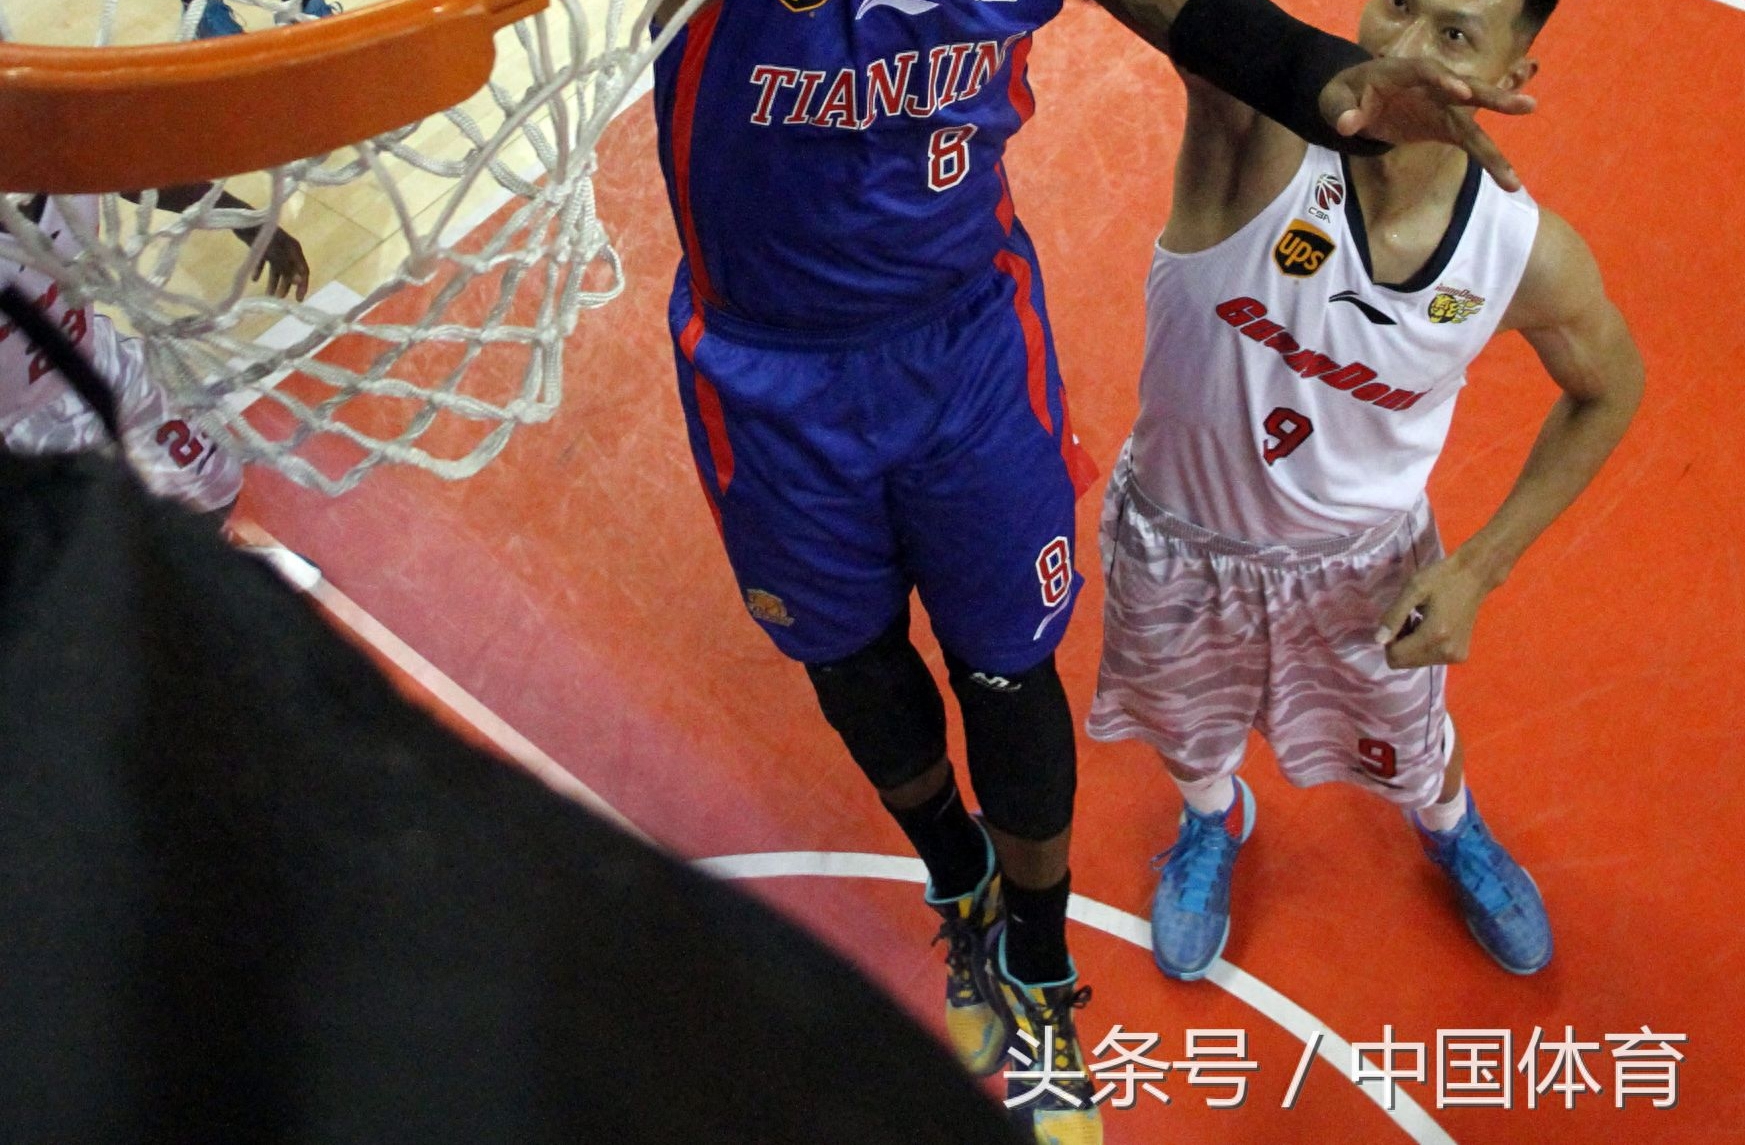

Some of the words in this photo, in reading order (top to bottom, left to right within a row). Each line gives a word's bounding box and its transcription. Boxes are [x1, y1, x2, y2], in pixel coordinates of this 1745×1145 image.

[928, 123, 978, 192] 8
[1279, 233, 1325, 270] ups
[1263, 407, 1314, 466] 9
[1035, 536, 1072, 607] 8
[1358, 738, 1397, 780] 9
